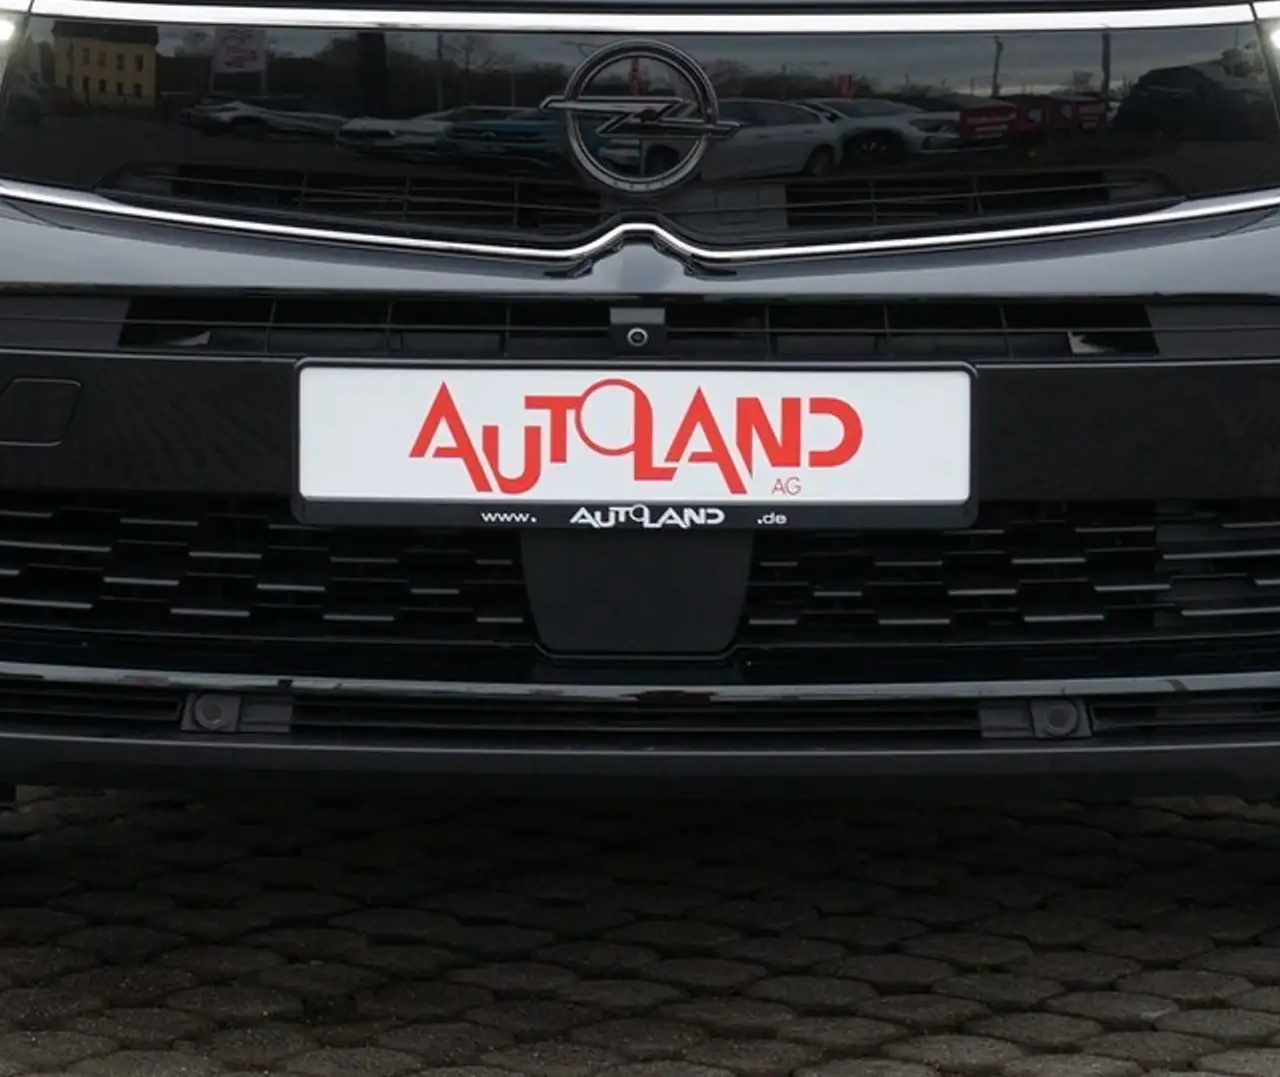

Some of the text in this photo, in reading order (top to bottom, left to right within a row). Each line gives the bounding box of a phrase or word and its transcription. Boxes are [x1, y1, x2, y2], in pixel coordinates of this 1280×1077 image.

[409, 378, 863, 495] AUTOLAND
[772, 478, 801, 496] AG
[481, 503, 787, 529] www. AUTOLAND .de
